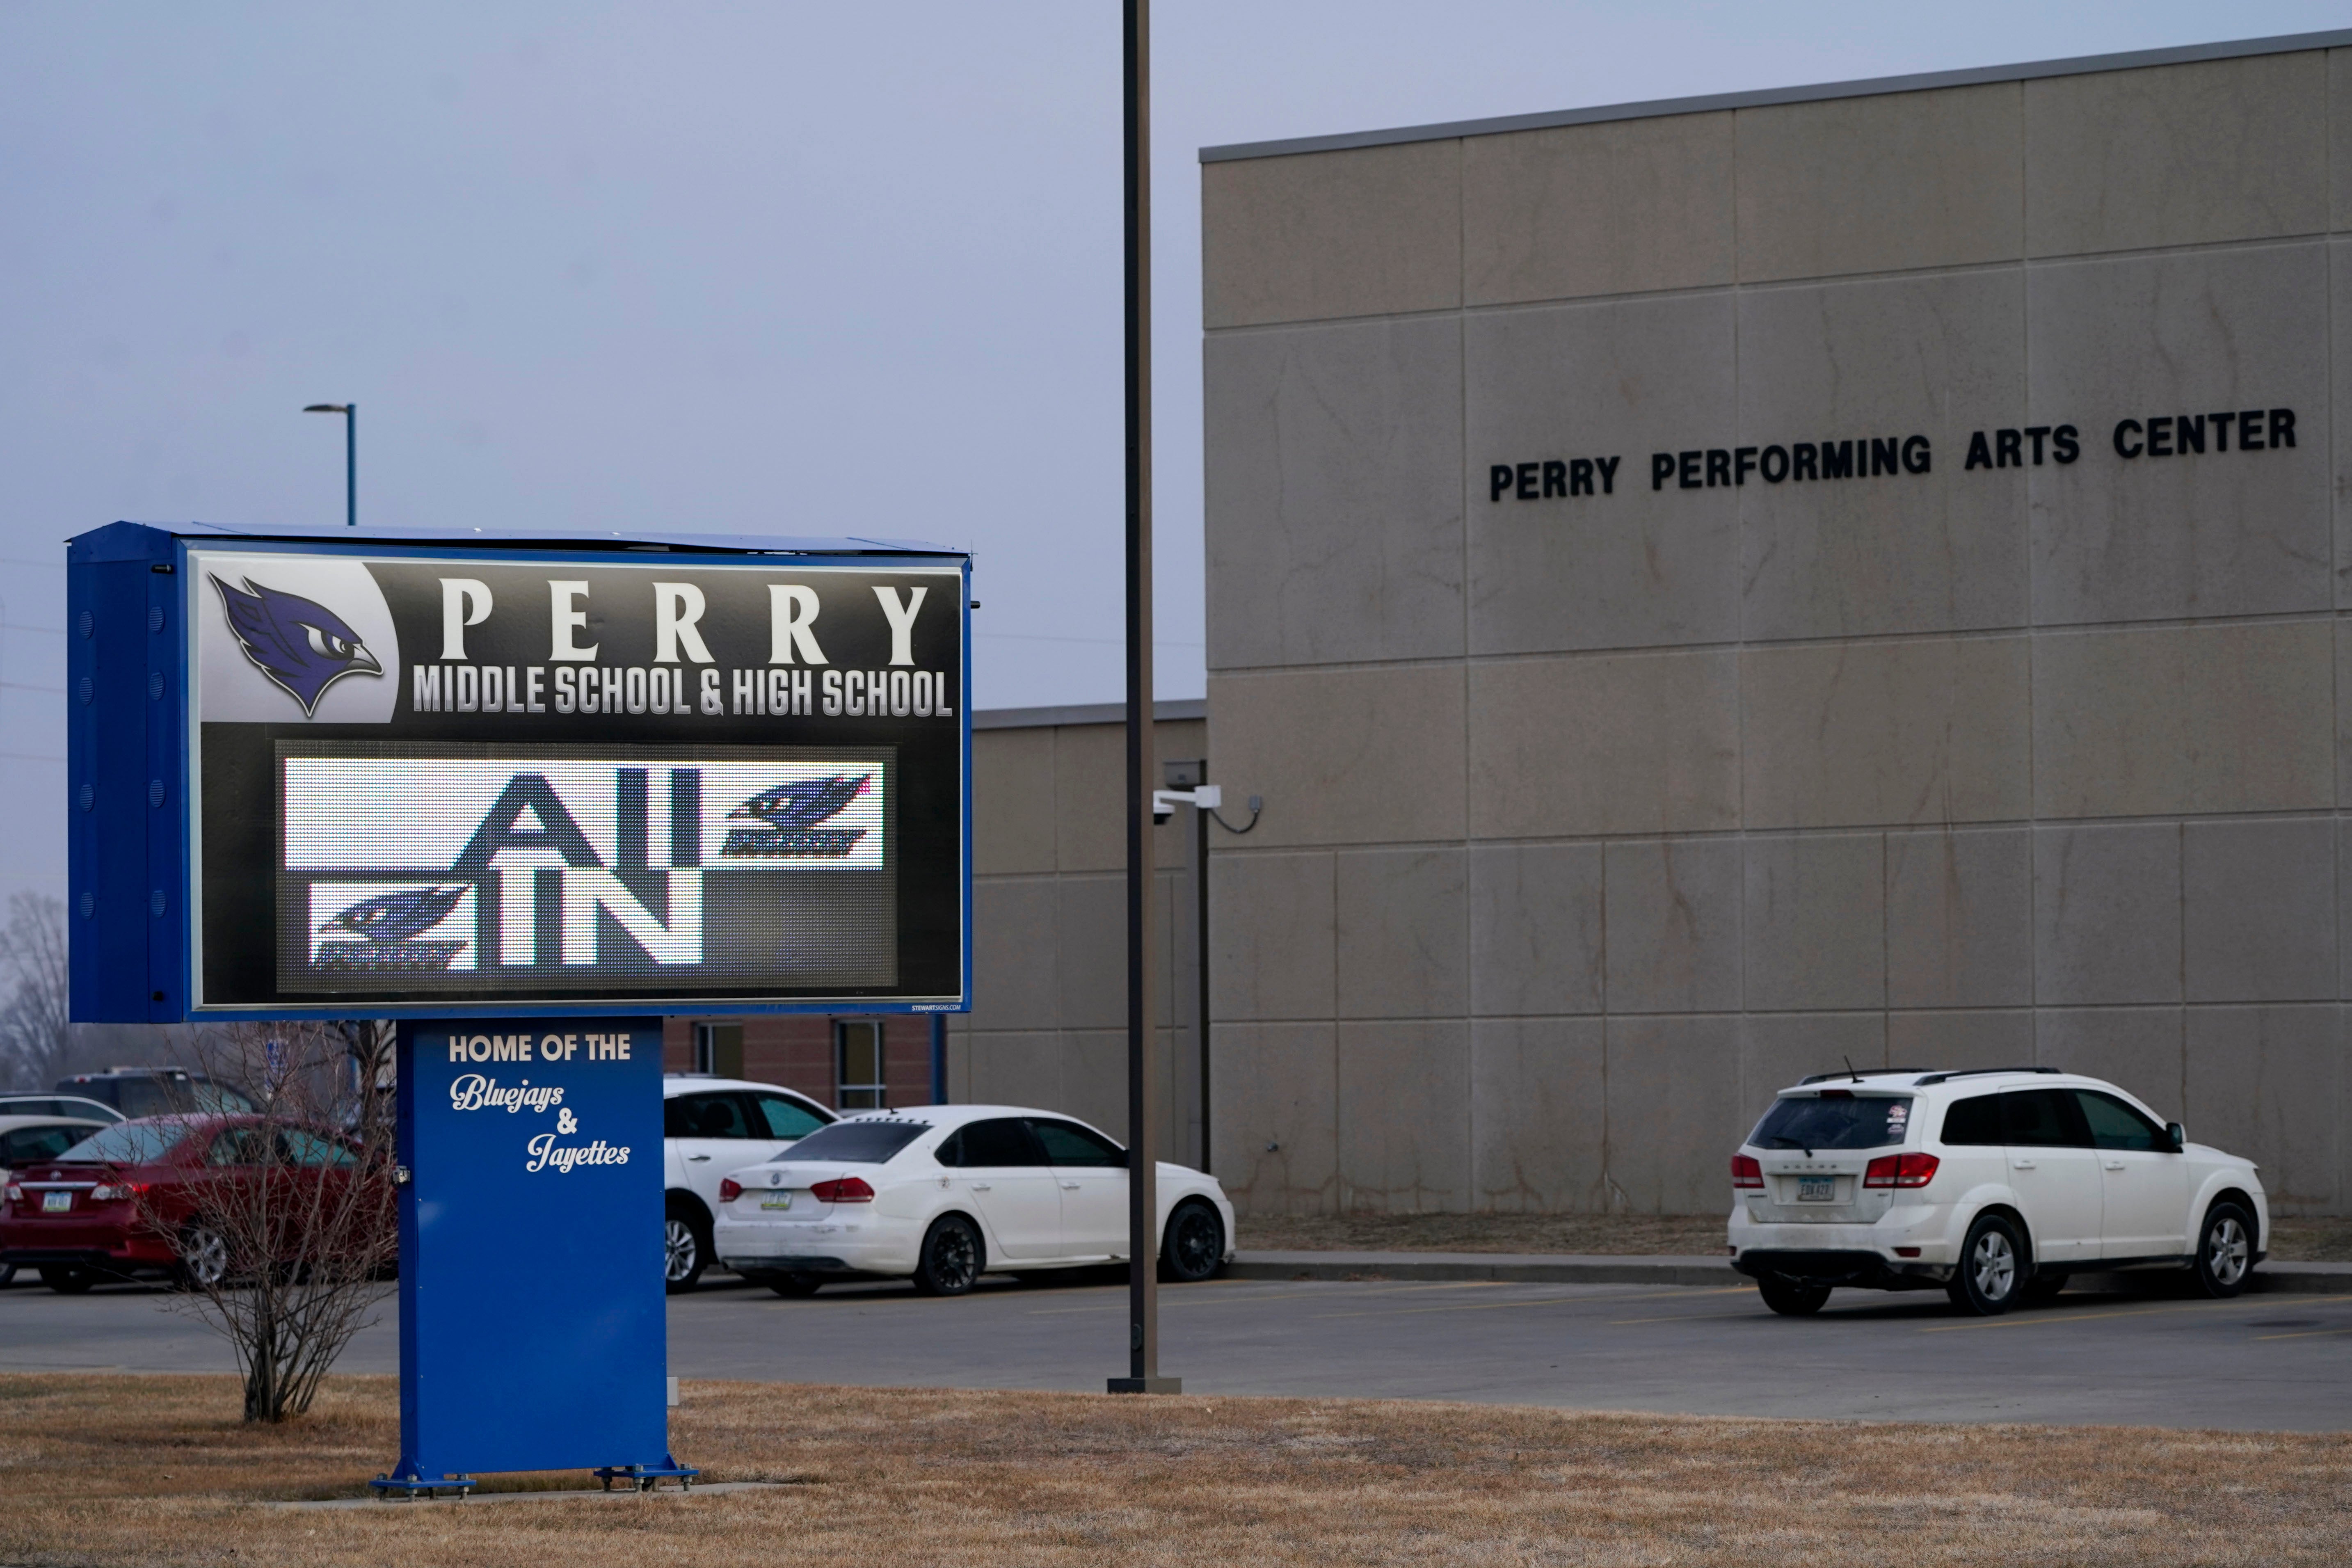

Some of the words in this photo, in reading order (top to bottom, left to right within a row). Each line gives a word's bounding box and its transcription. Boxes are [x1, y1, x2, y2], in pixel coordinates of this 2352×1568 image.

[1490, 455, 1621, 502] PERRY
[1652, 435, 1931, 491] PERFORMING
[1965, 424, 2080, 471] ARTS
[2113, 408, 2297, 459] CENTER
[438, 578, 928, 666] PERRY
[413, 665, 546, 713] MIDDLE
[555, 666, 691, 715] SCHOOL
[700, 668, 724, 716] &
[733, 669, 812, 715] HIGH
[822, 670, 953, 717] SCHOOL
[450, 1035, 532, 1062] HOME
[541, 1034, 577, 1061] OF
[585, 1034, 631, 1060] THE
[450, 1074, 564, 1113] Bluejays
[557, 1107, 578, 1135] &
[526, 1134, 631, 1173] Jayettes
